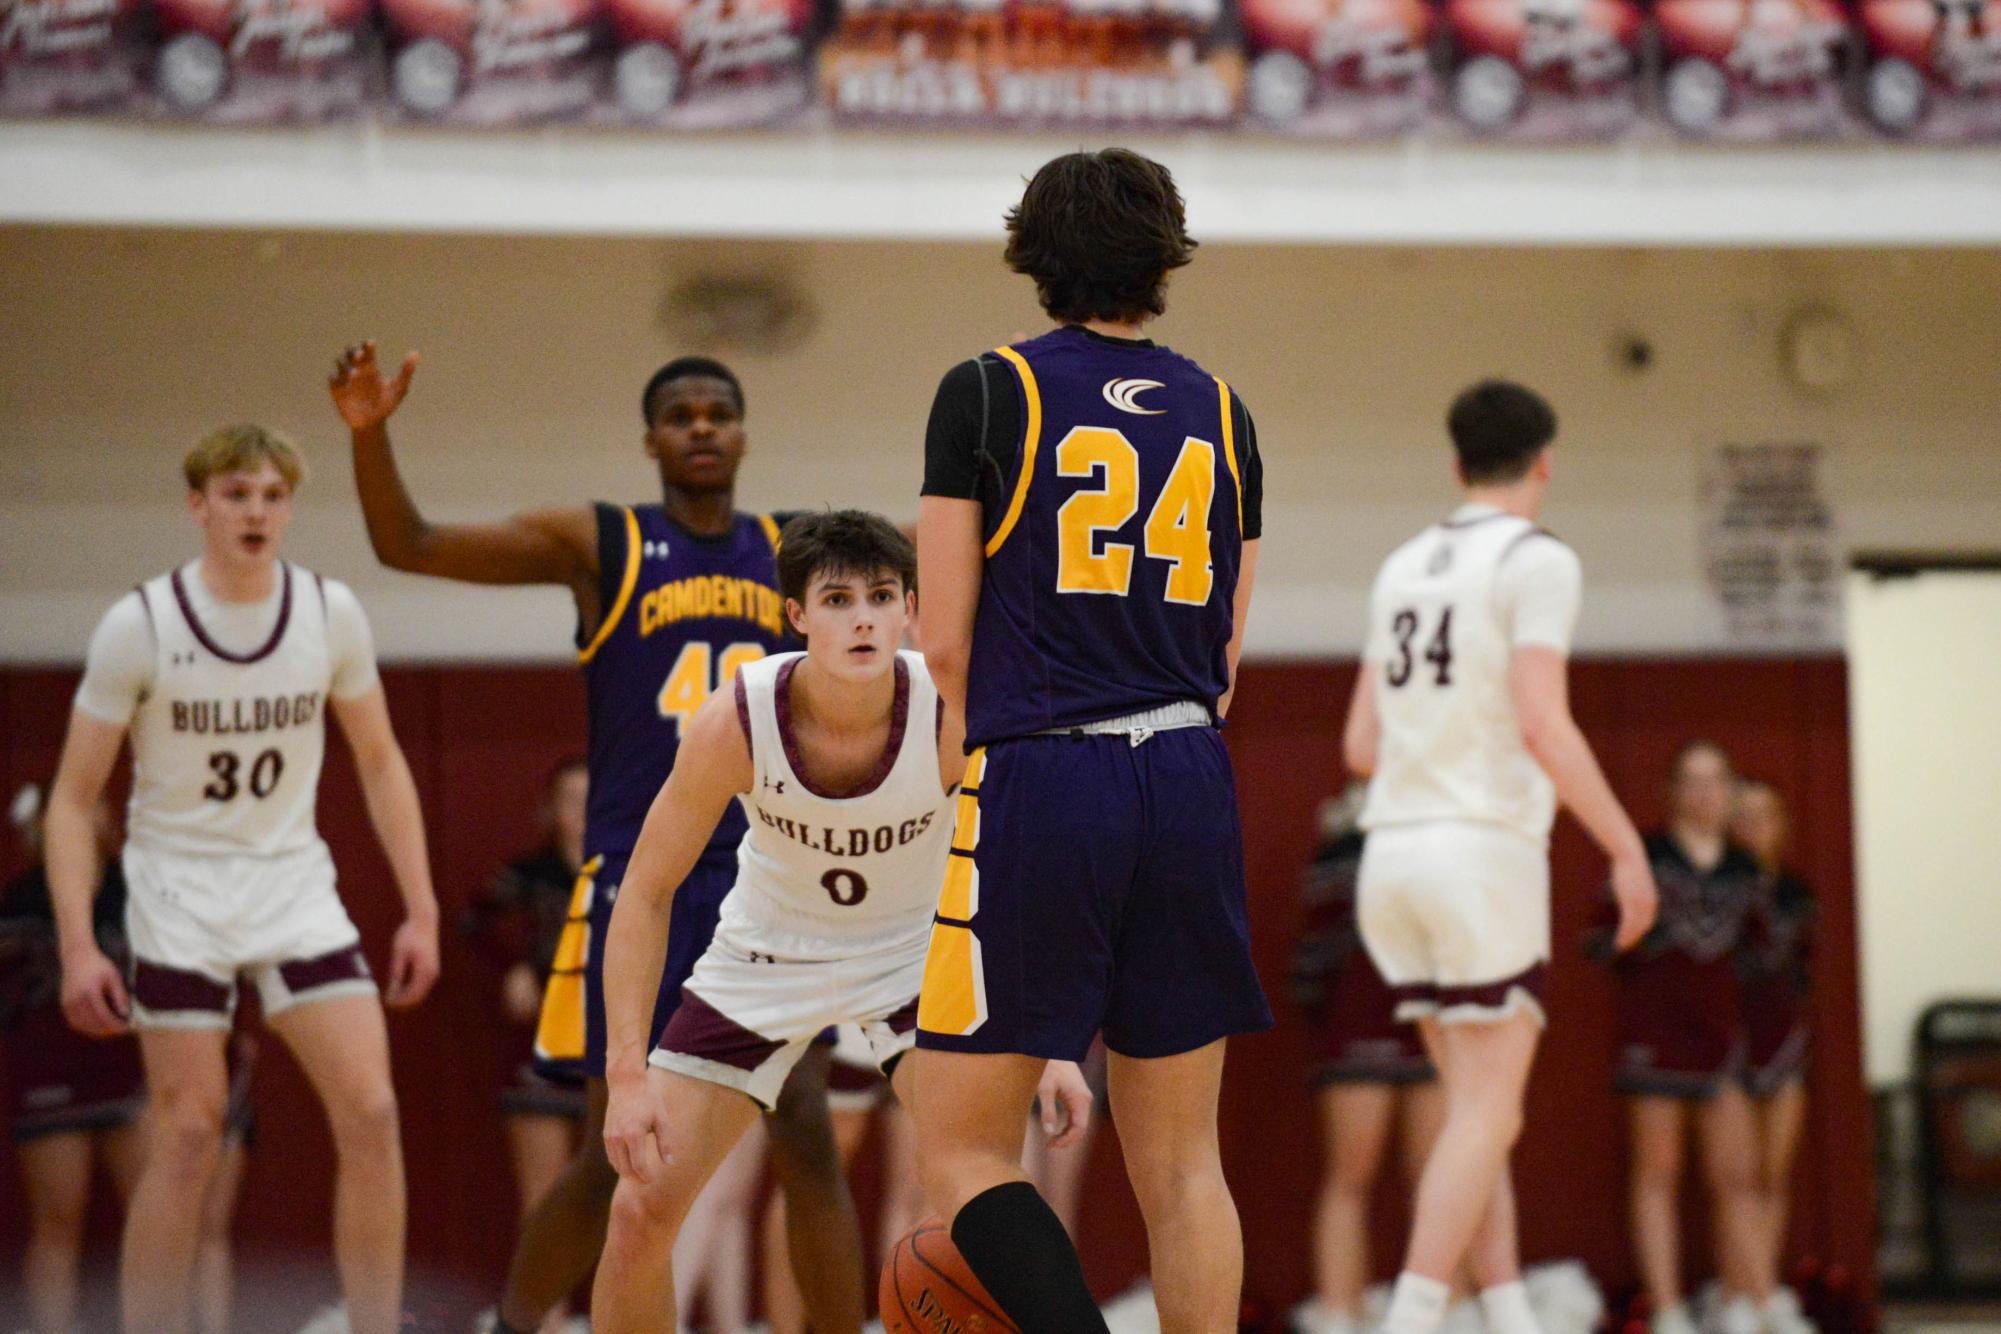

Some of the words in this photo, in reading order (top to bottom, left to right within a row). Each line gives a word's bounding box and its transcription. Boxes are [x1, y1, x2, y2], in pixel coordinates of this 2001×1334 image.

[1056, 425, 1215, 606] 24
[1386, 604, 1453, 689] 34
[204, 747, 284, 802] 30
[756, 804, 936, 857] BULLDOGS
[820, 868, 868, 907] 0
